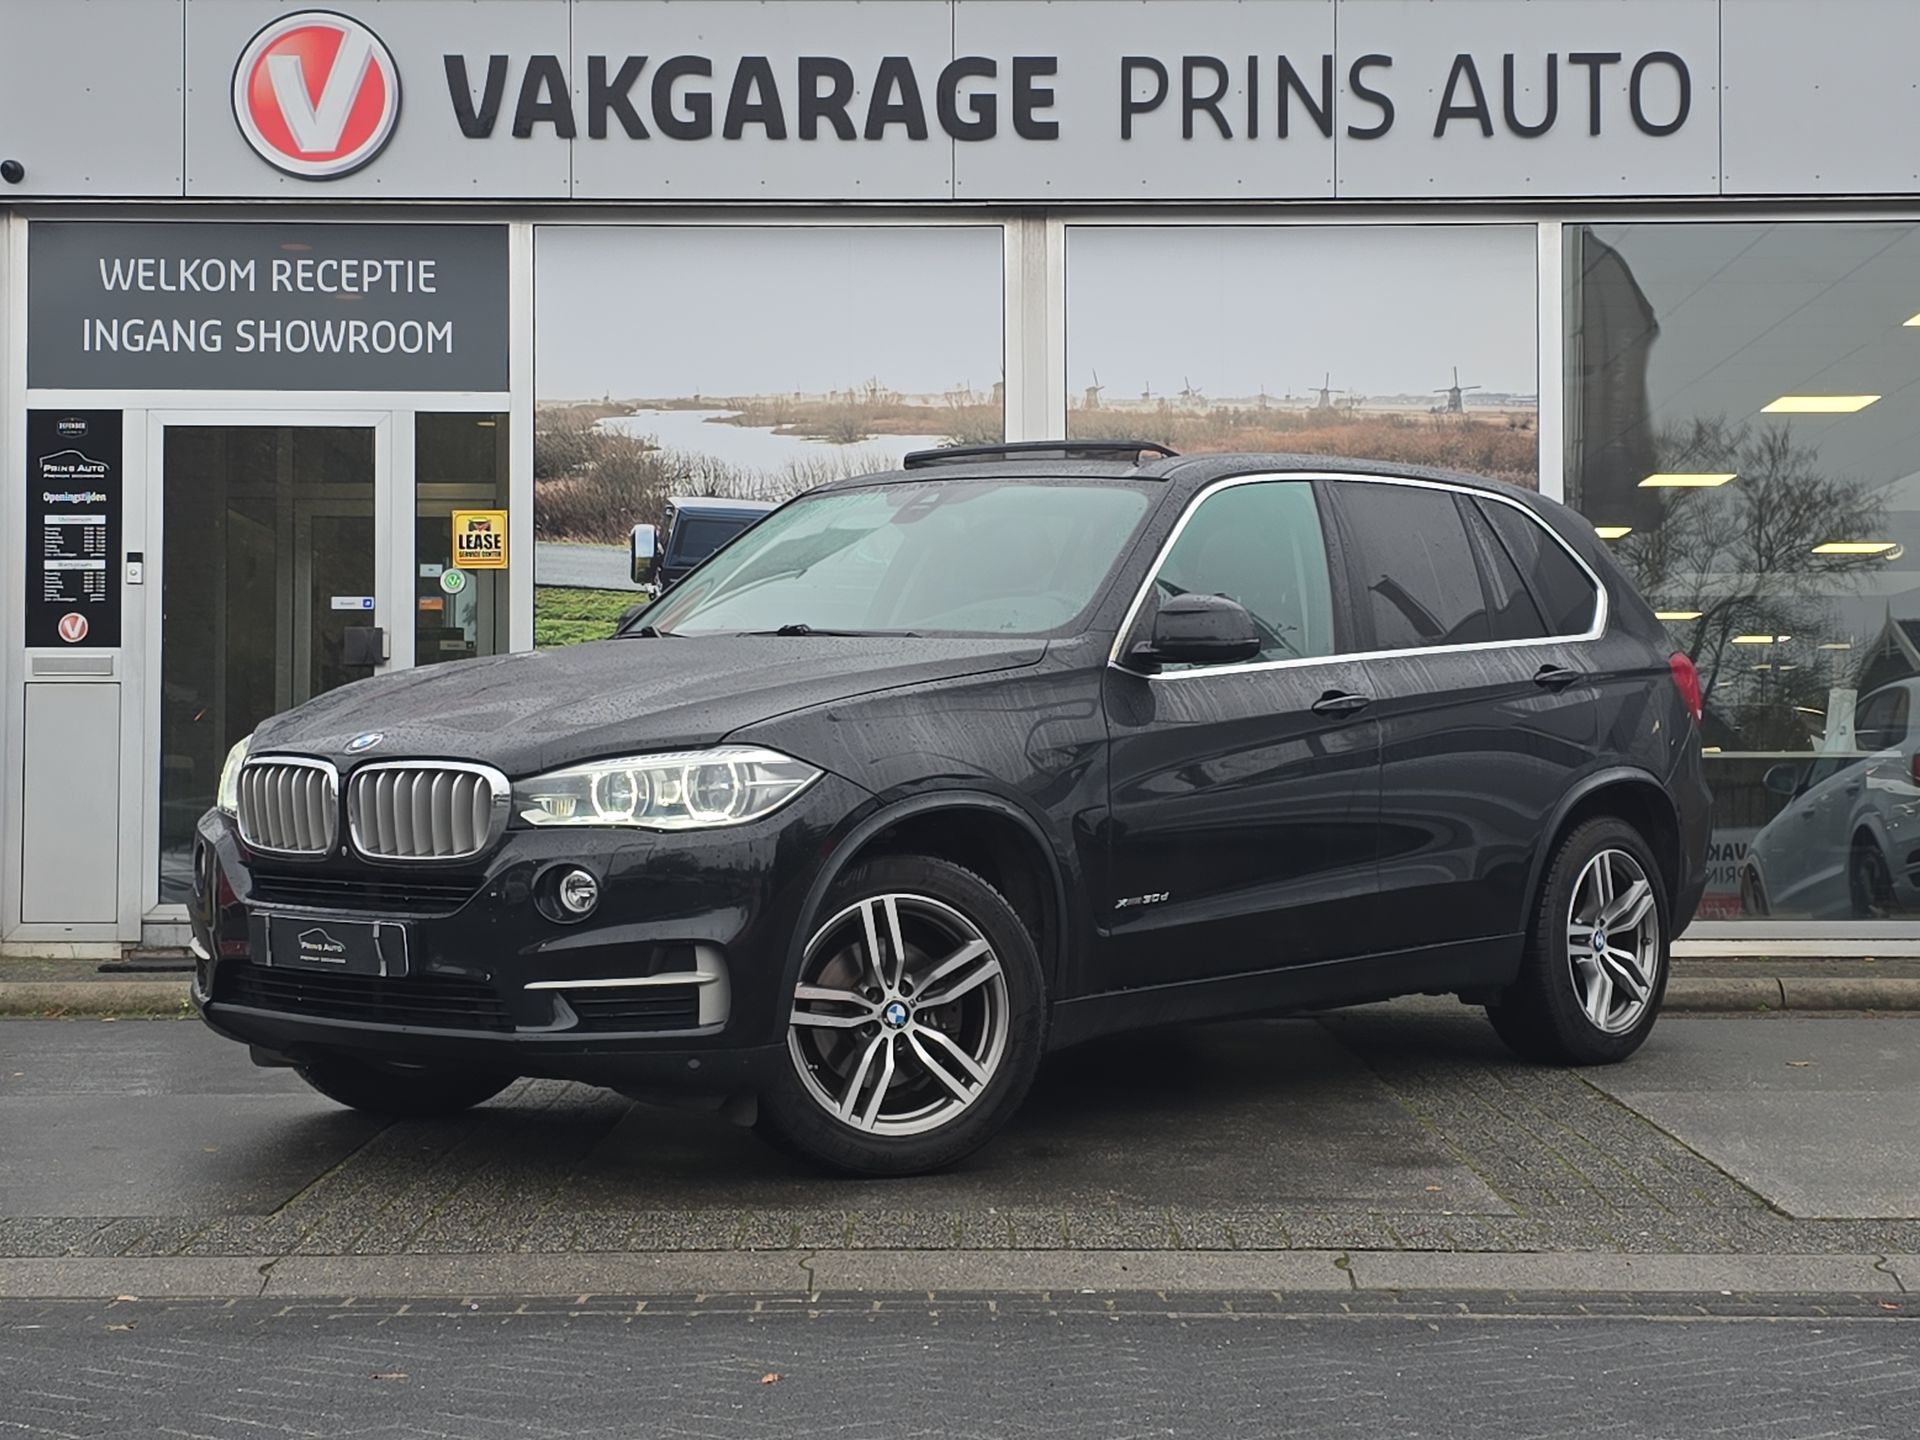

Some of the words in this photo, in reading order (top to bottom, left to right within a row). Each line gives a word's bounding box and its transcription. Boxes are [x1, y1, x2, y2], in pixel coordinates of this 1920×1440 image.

[443, 54, 1060, 142] VAKGARAGE
[1121, 54, 1396, 141] PRINS
[1433, 50, 1692, 139] AUTO
[99, 258, 256, 292] WELKOM
[271, 259, 437, 293] RECEPTIE
[82, 318, 223, 352] INGANG
[234, 320, 454, 354] SHOWROOM
[458, 534, 502, 550] LEASE
